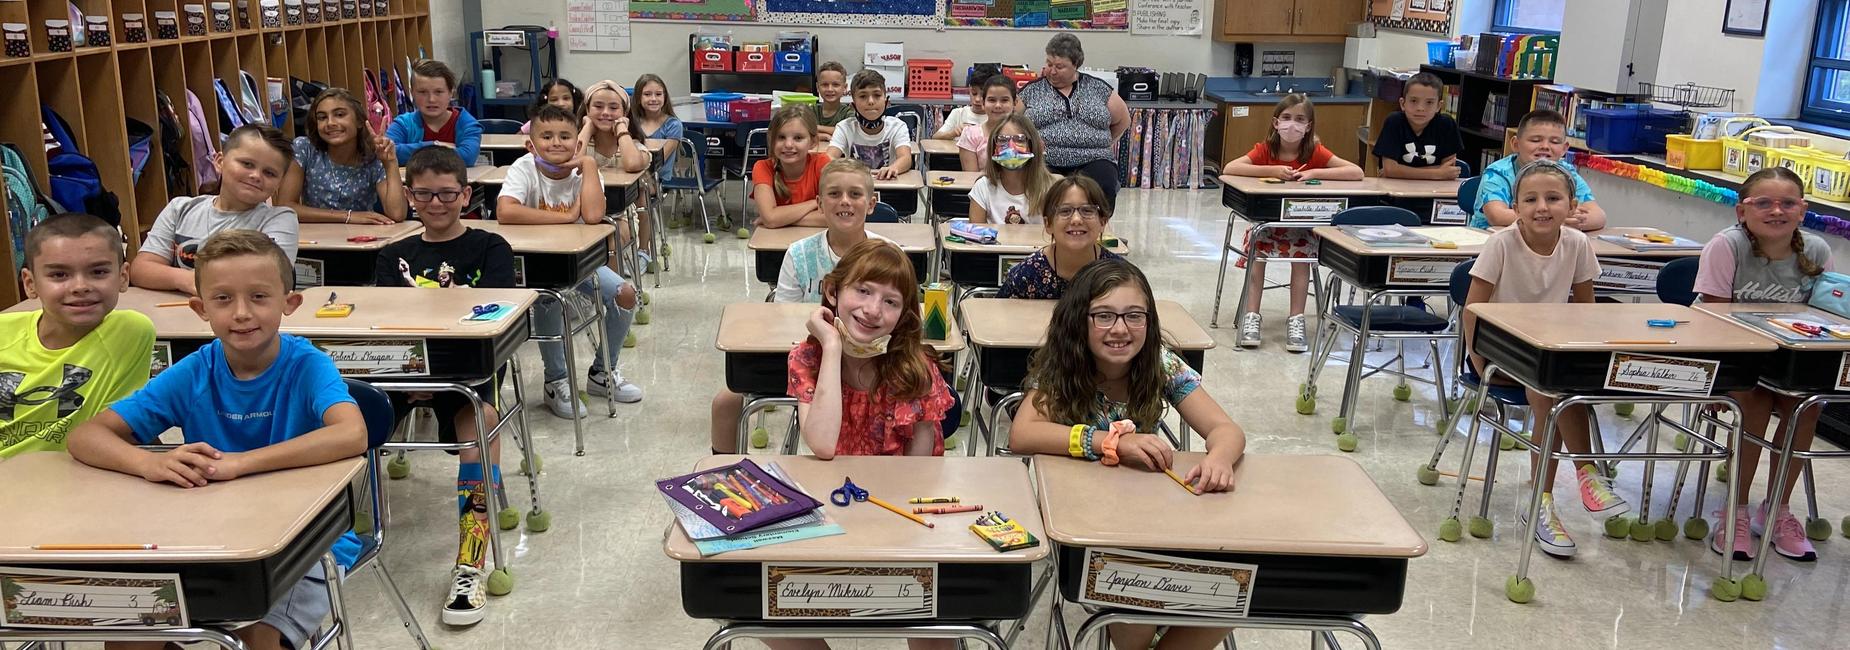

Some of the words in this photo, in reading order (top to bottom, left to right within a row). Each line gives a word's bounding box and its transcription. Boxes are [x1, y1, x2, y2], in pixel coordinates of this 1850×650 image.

[330, 351, 358, 362] Robert
[403, 351, 409, 361] 6
[1621, 363, 1650, 379] Sophia
[781, 582, 825, 603] Evelyn
[897, 584, 914, 598] 15
[1153, 577, 1192, 593] Davis
[1210, 582, 1221, 597] 4
[19, 591, 58, 607] Liam
[128, 594, 138, 608] 3
